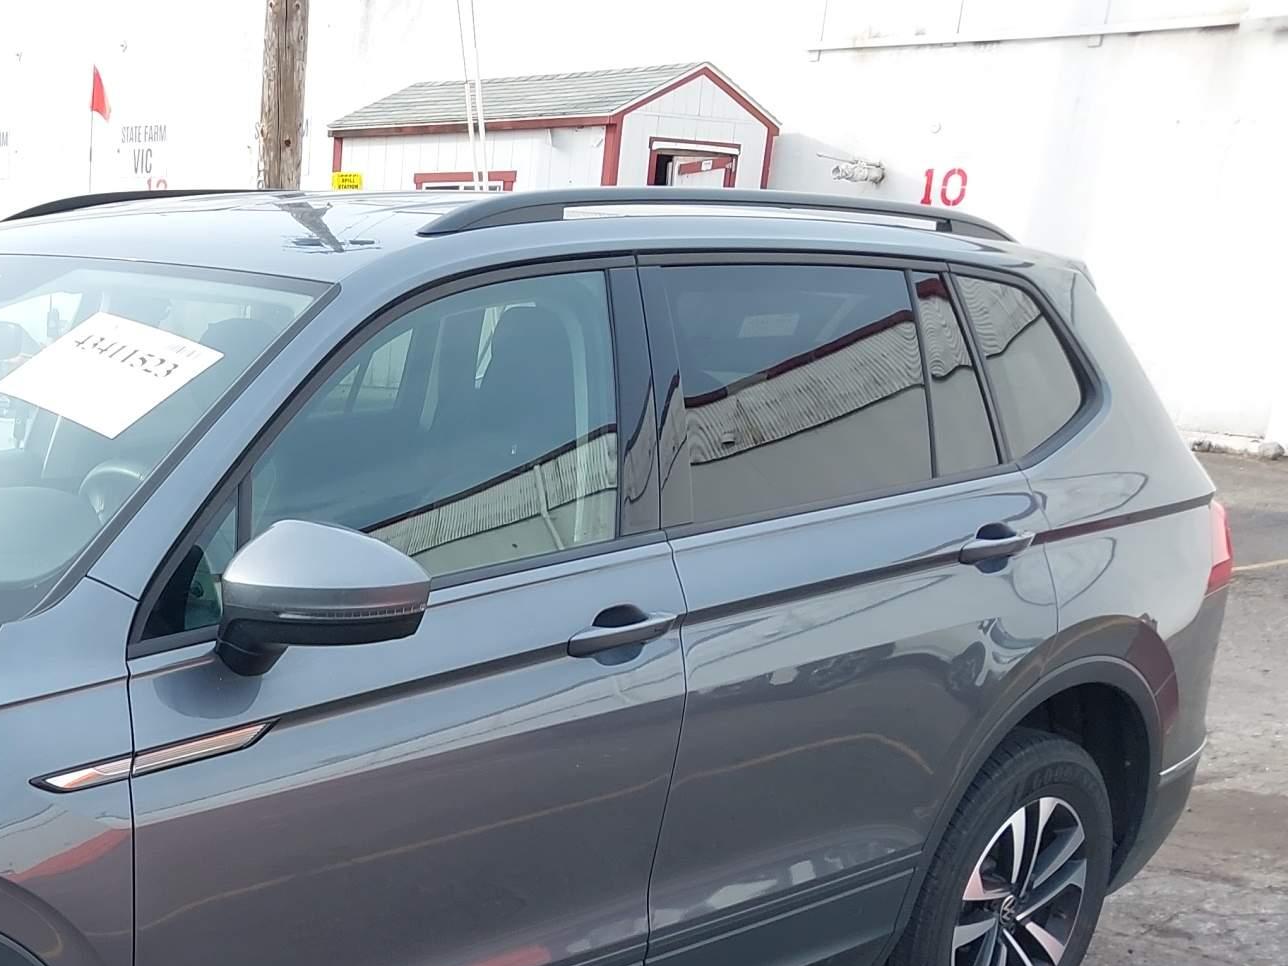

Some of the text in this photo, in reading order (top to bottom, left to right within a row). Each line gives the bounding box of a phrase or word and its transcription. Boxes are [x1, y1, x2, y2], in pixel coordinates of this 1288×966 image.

[121, 124, 167, 143] STATE FARM
[133, 148, 153, 174] VIC
[920, 168, 968, 206] 10
[74, 334, 179, 377] 43411523
